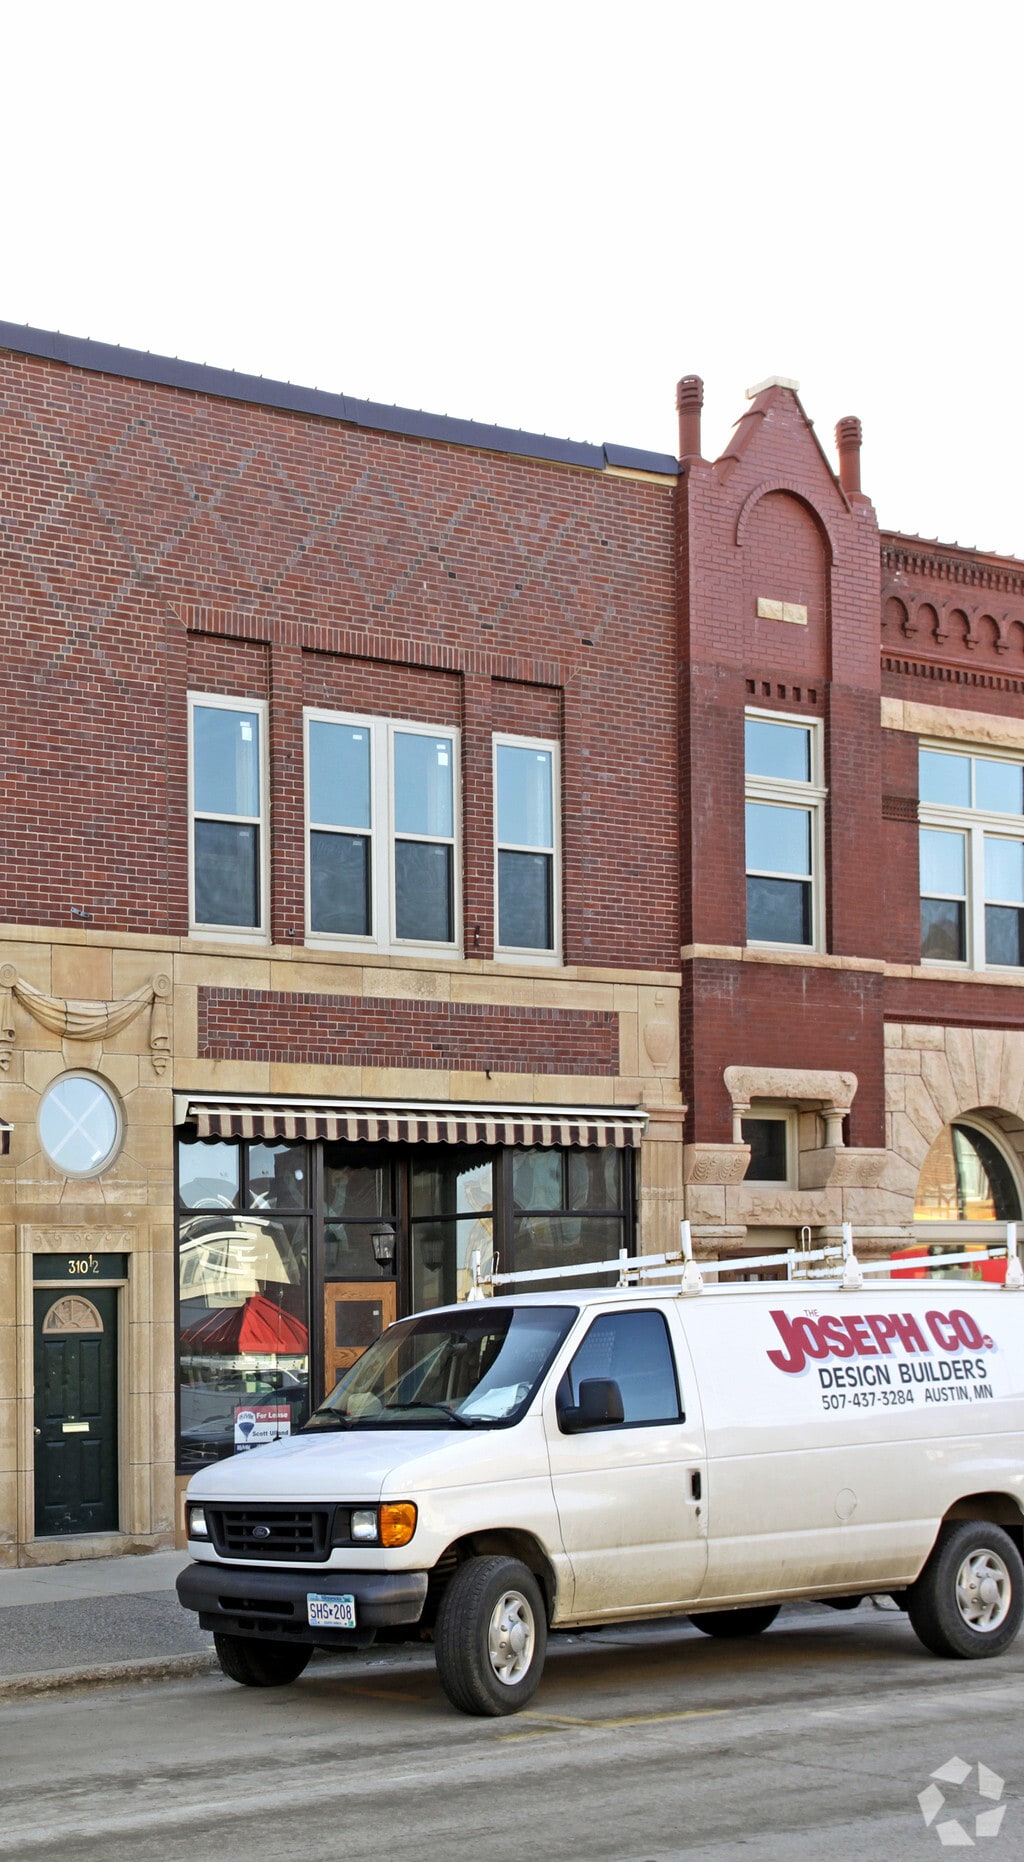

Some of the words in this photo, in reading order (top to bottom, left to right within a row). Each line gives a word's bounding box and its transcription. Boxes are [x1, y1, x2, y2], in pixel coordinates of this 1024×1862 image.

[803, 1309, 820, 1317] THE
[766, 1310, 929, 1373] JOSEPH
[818, 1364, 891, 1389] DESIGN
[898, 1358, 987, 1384] BUILDERS
[822, 1389, 914, 1410] 507-437-3284
[925, 1386, 972, 1403] AUSTIN,
[973, 1384, 994, 1399] MN
